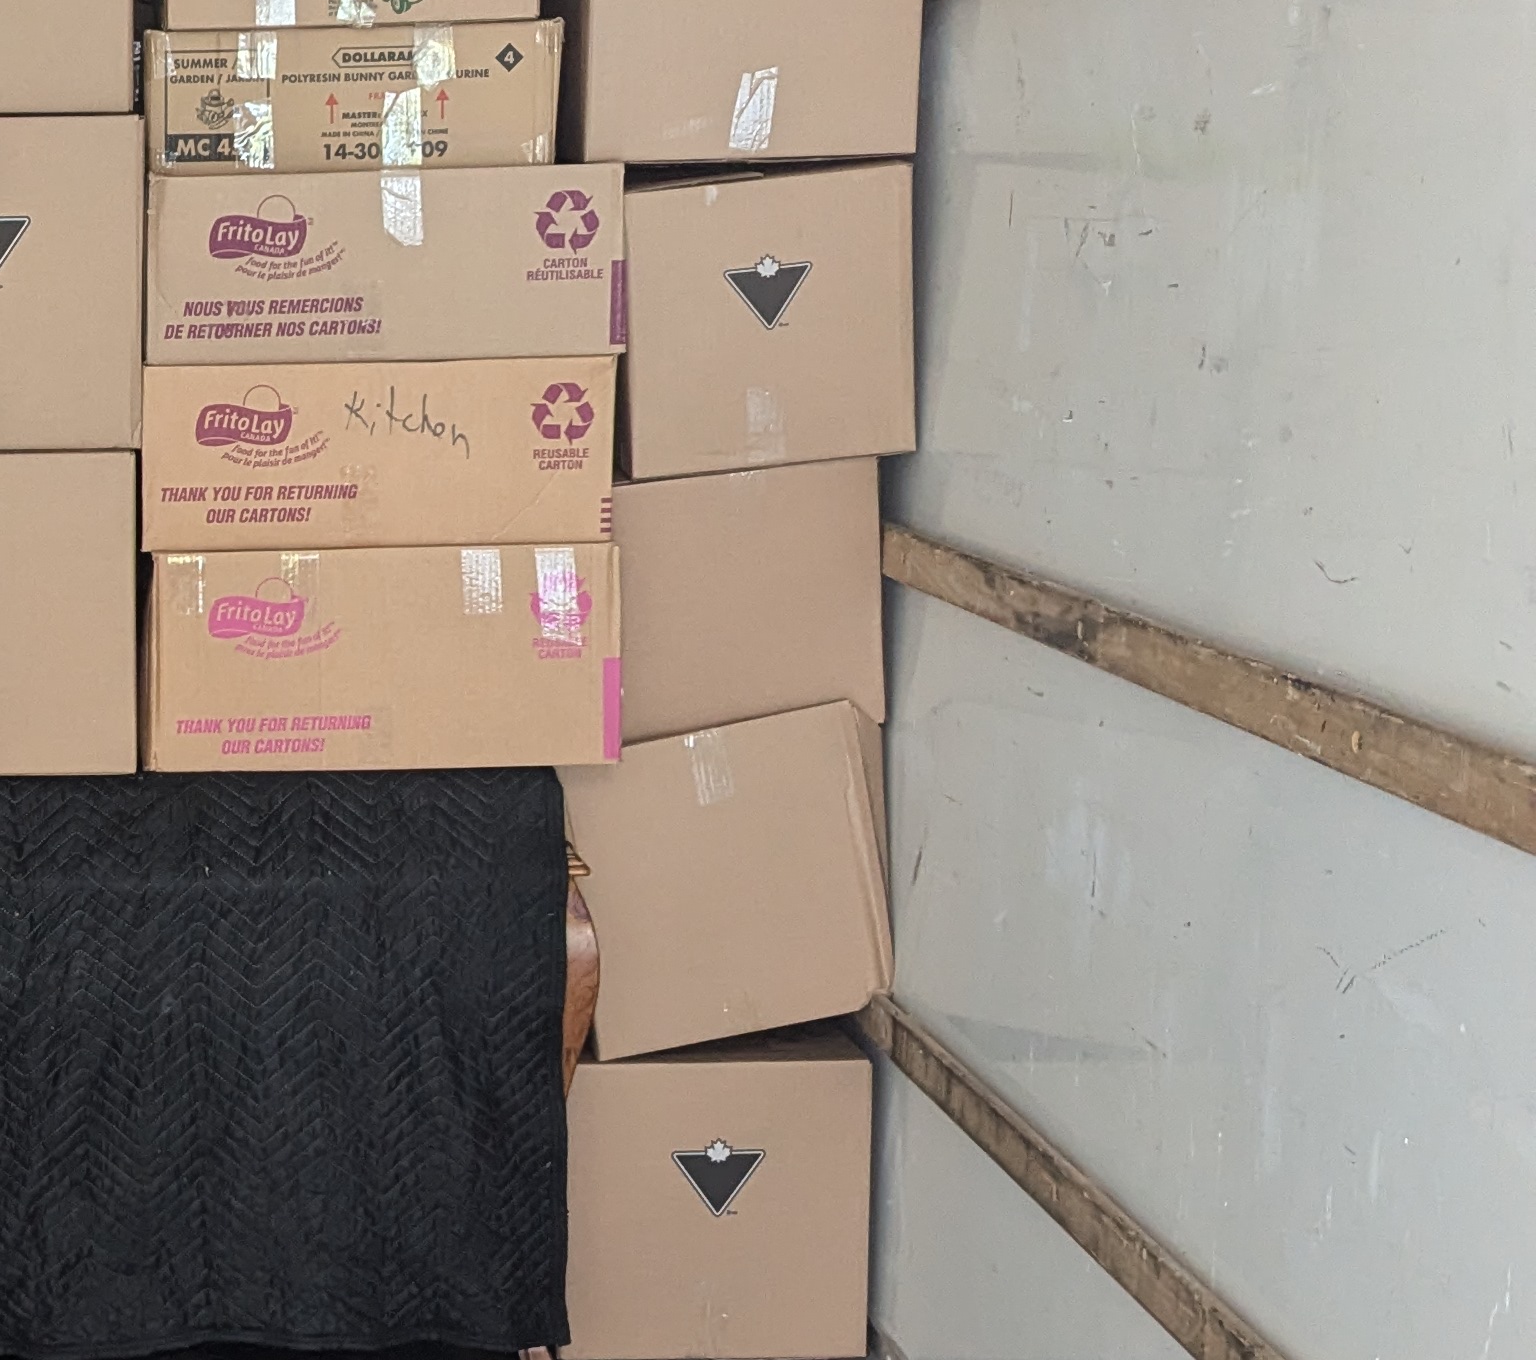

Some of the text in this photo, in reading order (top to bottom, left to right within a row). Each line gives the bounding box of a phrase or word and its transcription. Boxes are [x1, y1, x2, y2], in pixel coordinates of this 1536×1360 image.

[174, 58, 228, 69] SUMMER
[342, 50, 414, 63] DOLLARA
[504, 50, 515, 64] 4
[170, 74, 215, 84] GARDEN
[281, 72, 341, 83] POLYRESIN
[344, 72, 385, 82] BUNNY
[177, 138, 210, 157] MC
[254, 244, 285, 255] CANADA
[245, 256, 267, 269] food
[268, 259, 282, 271] for
[284, 259, 297, 269] the
[300, 257, 314, 269] fun
[315, 251, 325, 262] of
[543, 257, 588, 269] CARTON
[235, 264, 256, 277] pour
[257, 269, 266, 279] le
[267, 269, 295, 281] plaisir
[296, 267, 307, 277] de
[526, 268, 604, 281] RÉUTILISABLE
[183, 297, 364, 317] NOUS VOUS REMERCIONS
[164, 319, 382, 340] DE RETOURNER NOS CARTONS!
[240, 431, 271, 442] CANADA
[231, 444, 252, 457] food
[254, 448, 267, 459] for
[269, 448, 283, 457] the
[300, 439, 309, 450] of
[533, 447, 590, 459] REUSABLE
[220, 452, 242, 464] pour
[244, 458, 251, 467] le
[538, 459, 583, 470] CARTON
[161, 483, 359, 503] THANK YOU FOR RETURNING
[206, 506, 312, 524] OUR CARTONS!
[176, 715, 372, 734] THANK YOU FOR RETURNING
[221, 738, 325, 754] OUR CARTONS!
